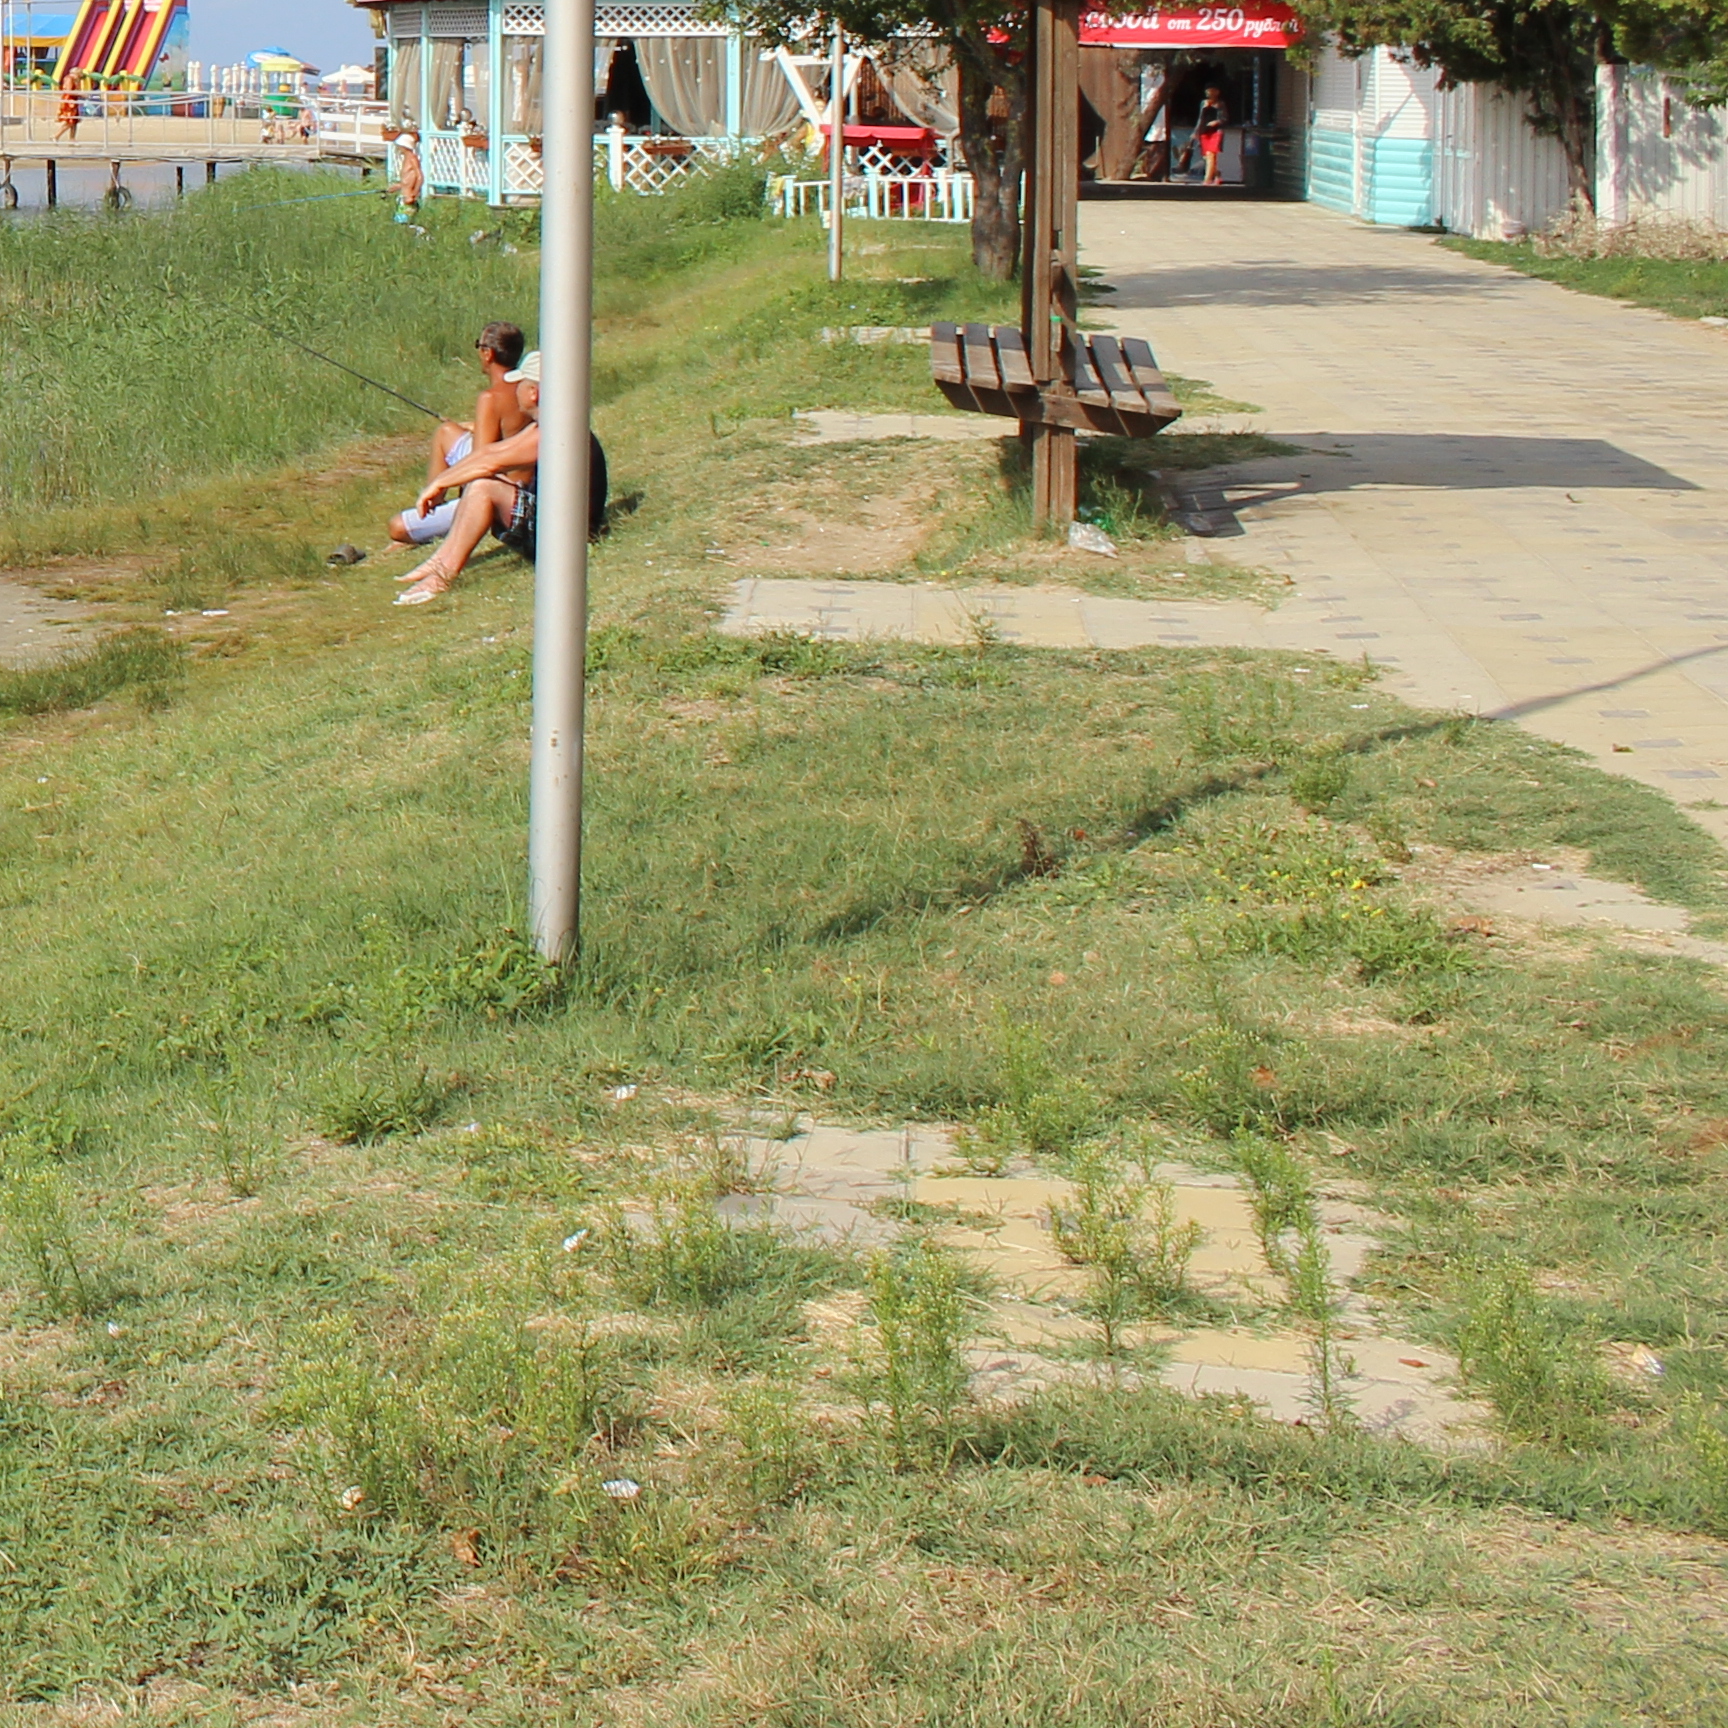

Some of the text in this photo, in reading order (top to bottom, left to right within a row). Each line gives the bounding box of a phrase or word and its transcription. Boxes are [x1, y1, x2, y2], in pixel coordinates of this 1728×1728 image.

[1167, 18, 1192, 30] от
[1195, 7, 1245, 31] 250
[1243, 17, 1300, 38] рублй
